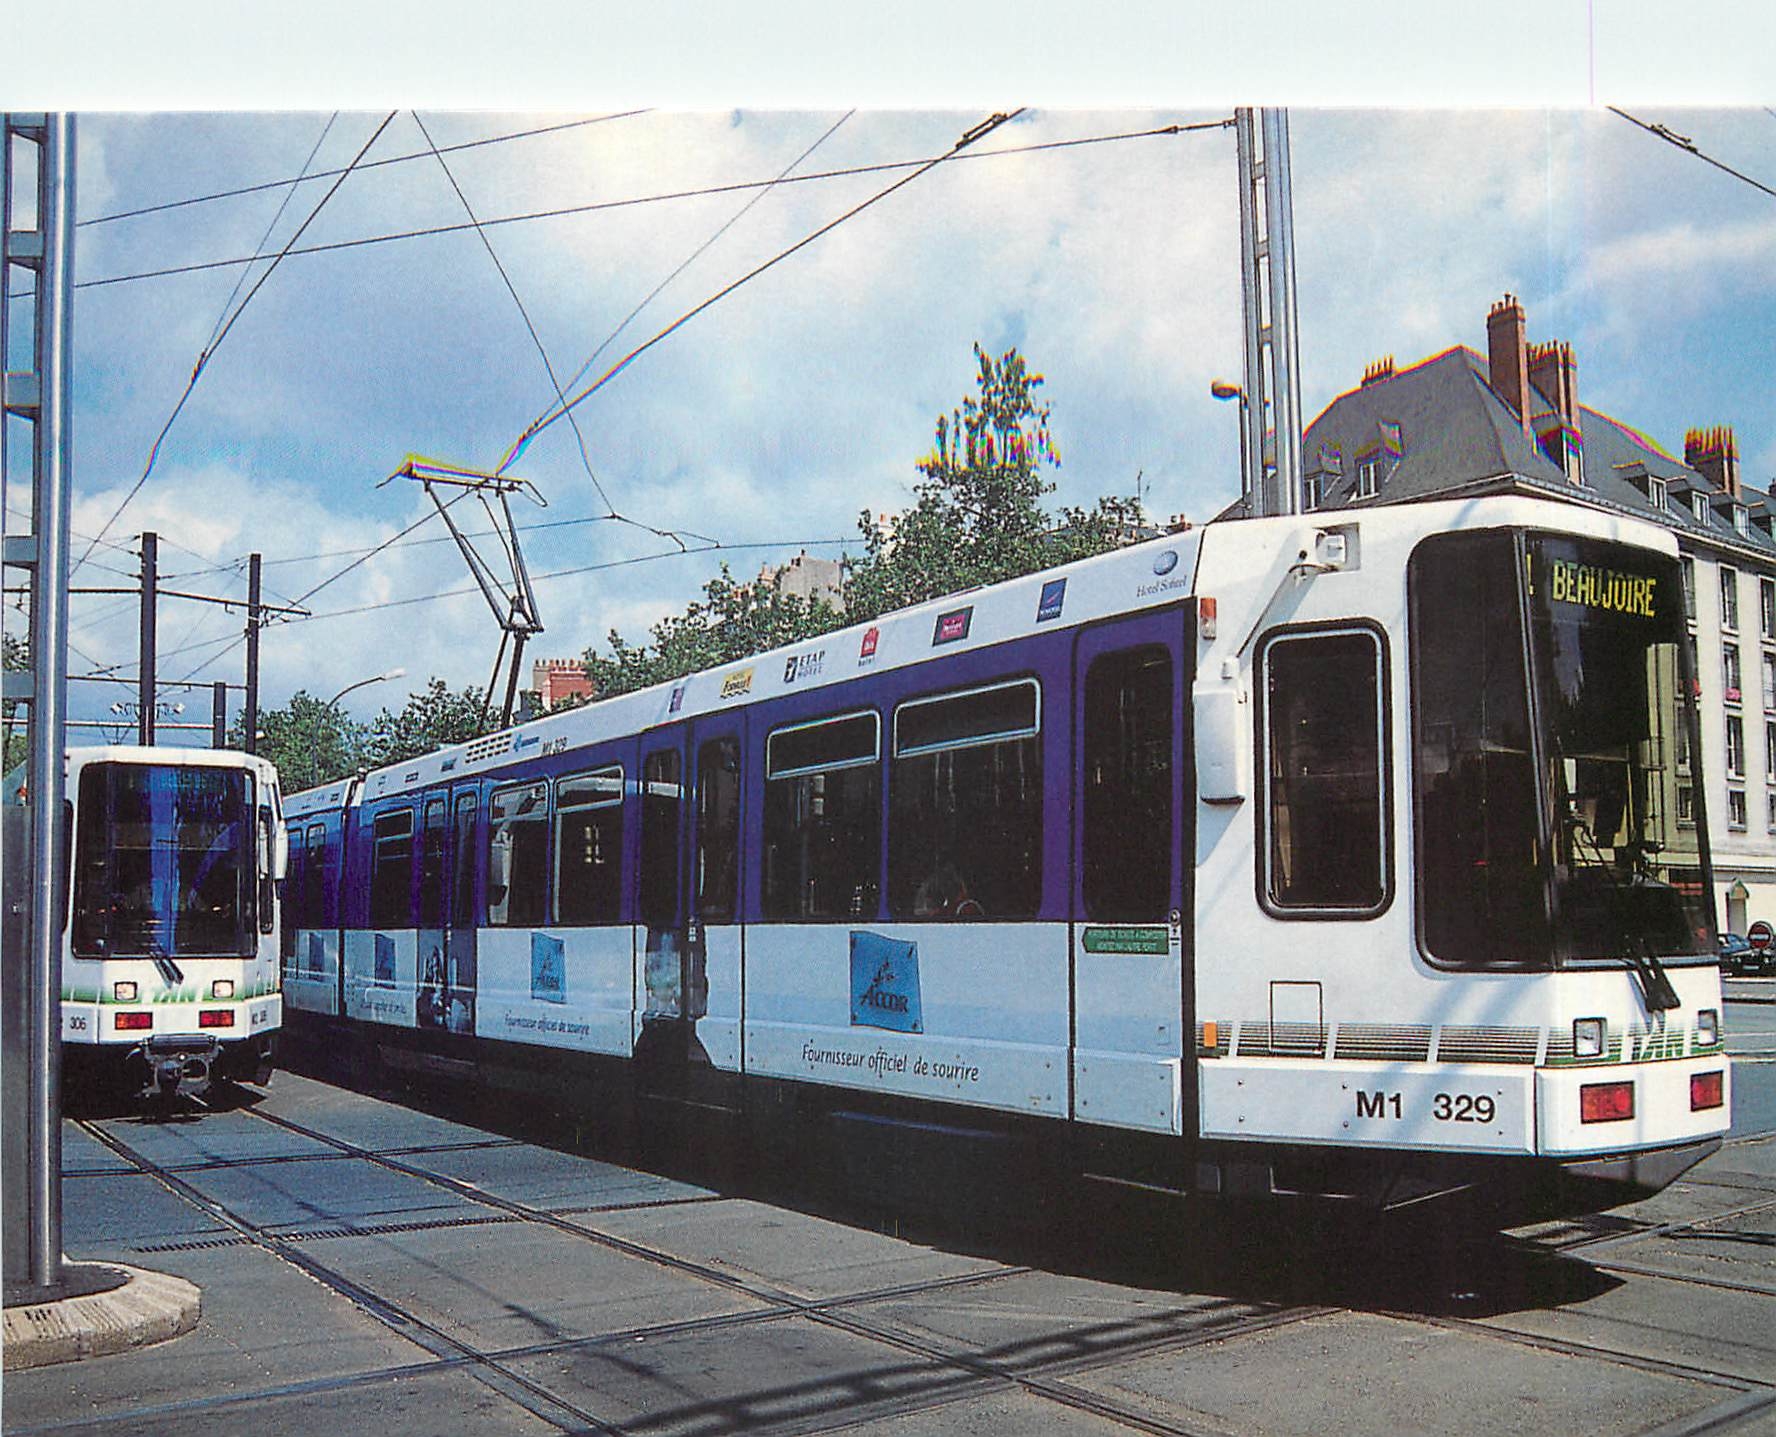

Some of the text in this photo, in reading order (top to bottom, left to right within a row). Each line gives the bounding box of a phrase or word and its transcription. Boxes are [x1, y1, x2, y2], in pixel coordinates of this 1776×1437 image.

[1553, 559, 1657, 618] BEAUJOIRE
[801, 650, 825, 666] ETAP
[70, 1016, 87, 1030] 306
[802, 1044, 979, 1082] Fournisseur officiel de sourire
[1356, 1090, 1496, 1124] M1 329
